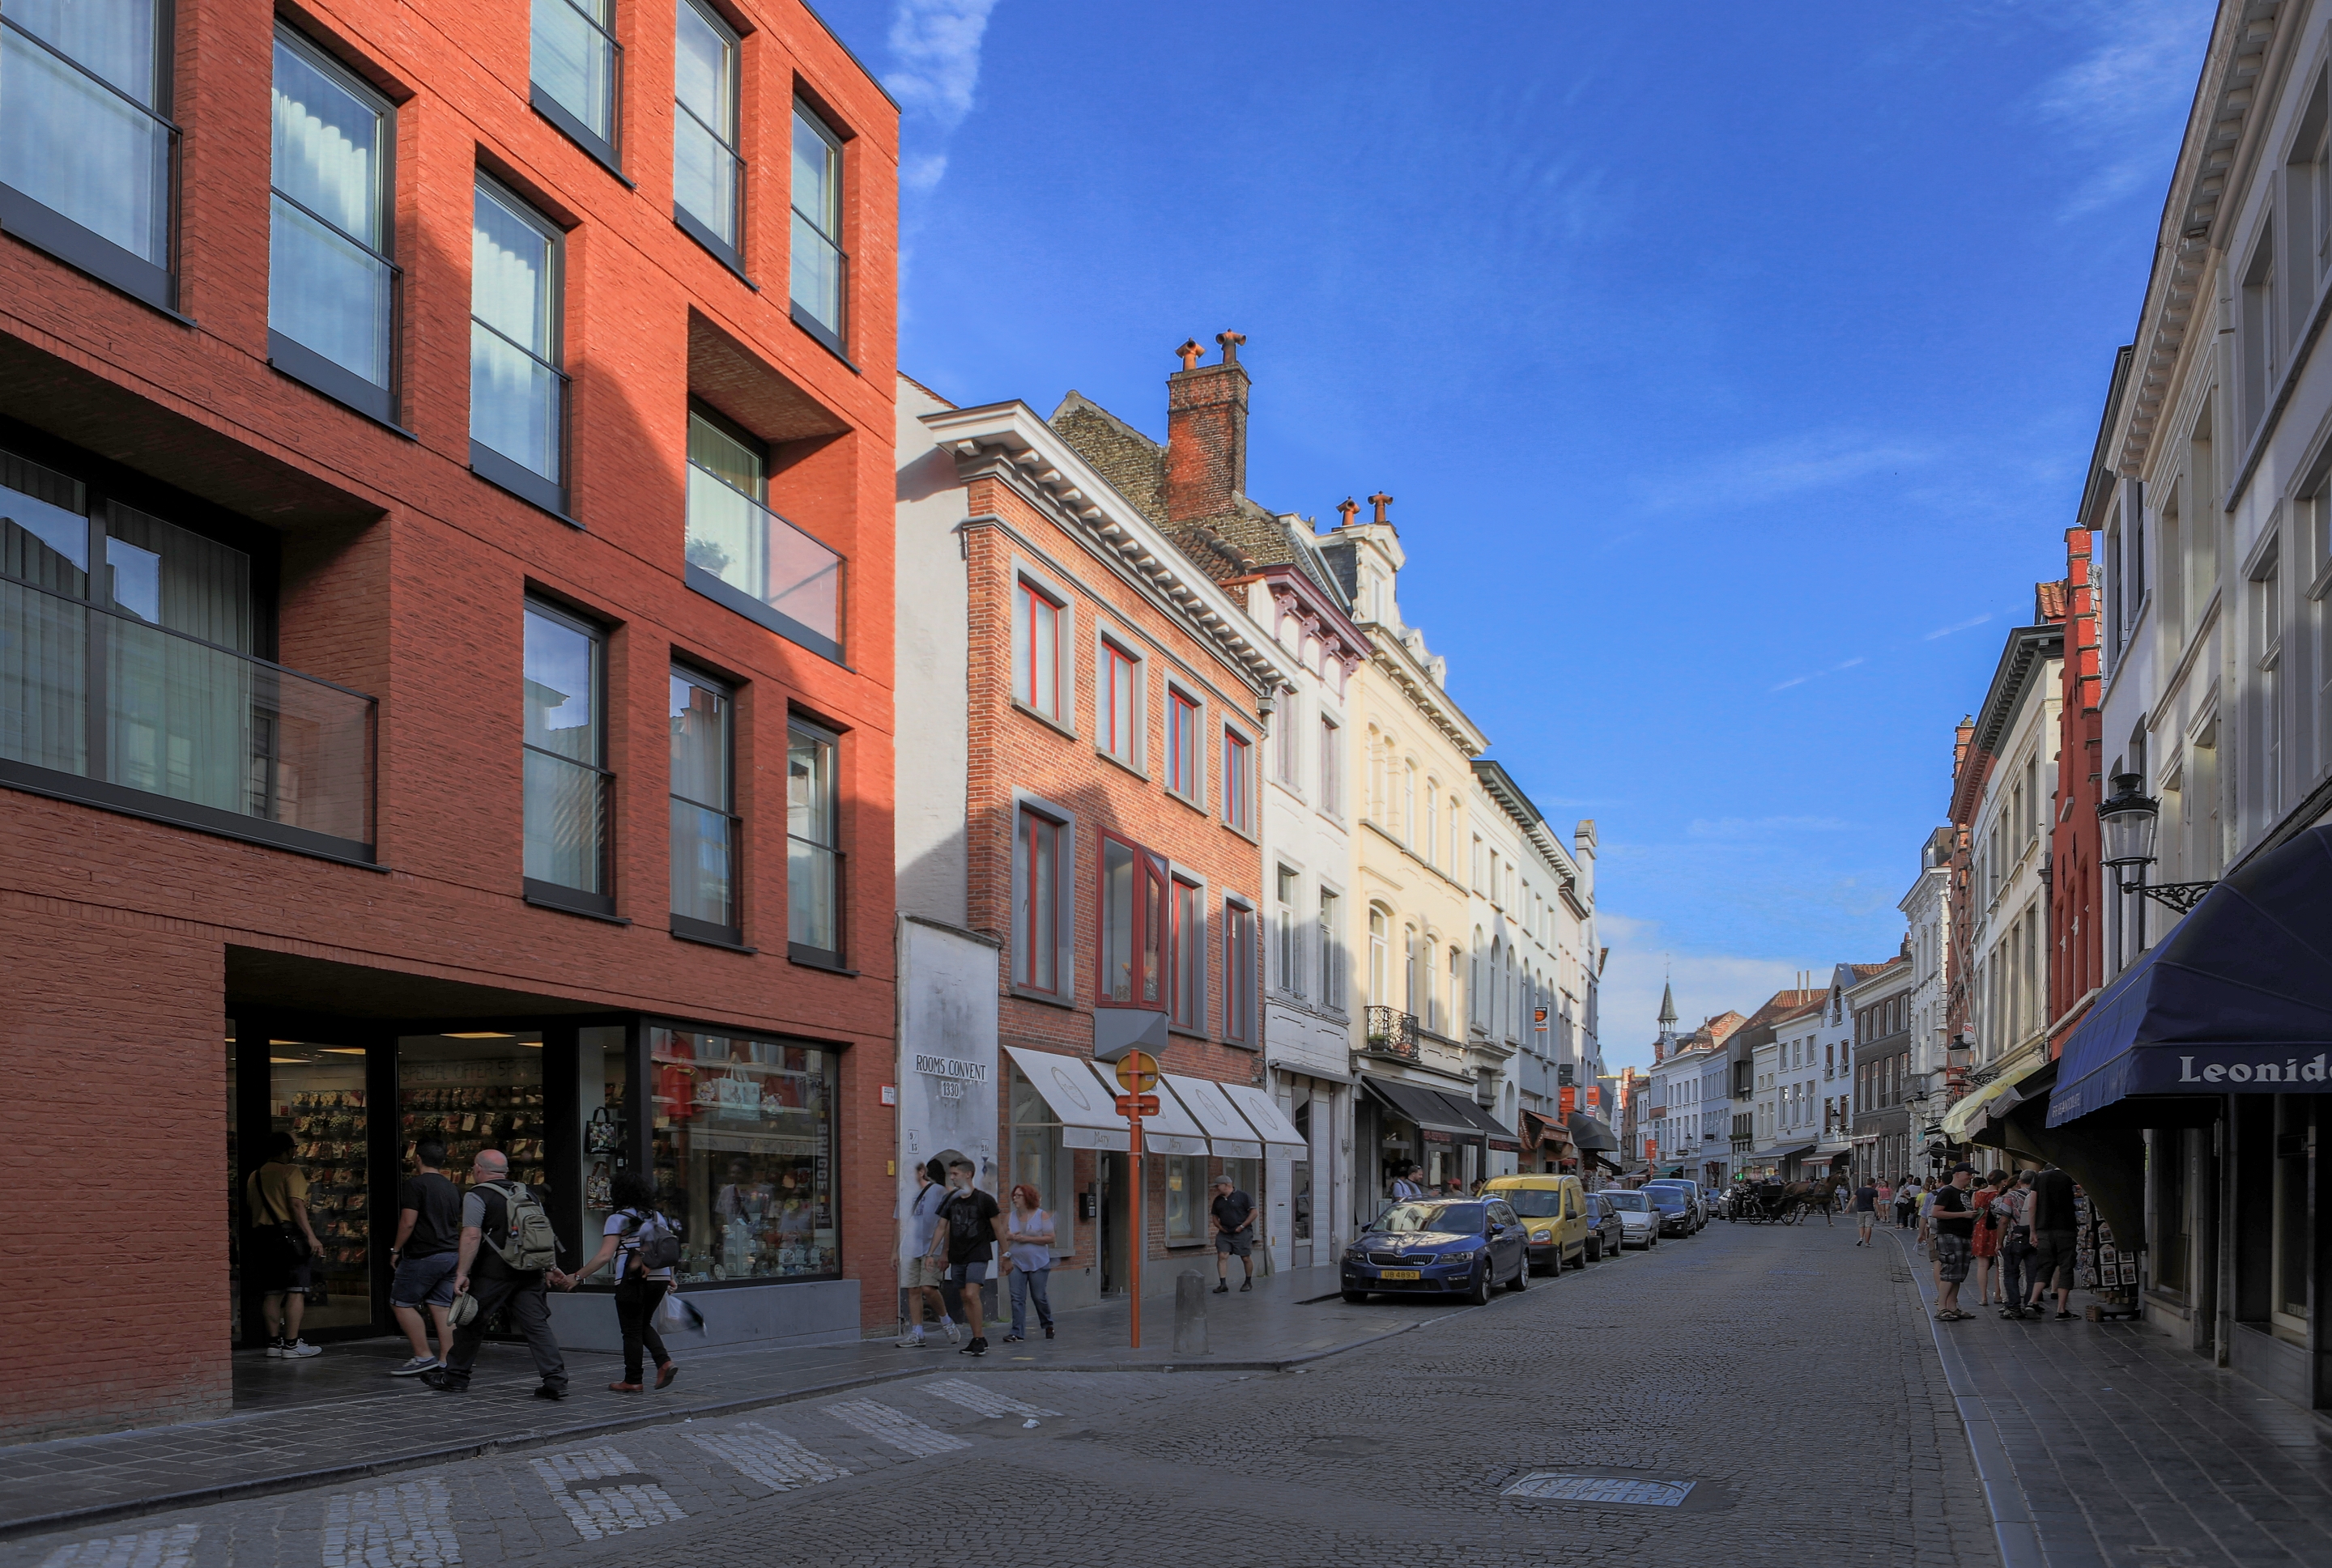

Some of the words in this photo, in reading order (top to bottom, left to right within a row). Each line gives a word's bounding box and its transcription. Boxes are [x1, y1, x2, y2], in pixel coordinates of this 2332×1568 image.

[401, 1064, 448, 1082] SPECIAL
[454, 1060, 493, 1080] OFFER
[916, 1055, 946, 1074] ROOMS
[948, 1060, 986, 1081] CONVENT
[942, 1081, 960, 1097] 1330
[1094, 1131, 1110, 1146] Mary
[1169, 1138, 1182, 1152] Mary
[1231, 1142, 1242, 1155] Mary
[816, 1124, 828, 1190] BRUGGE
